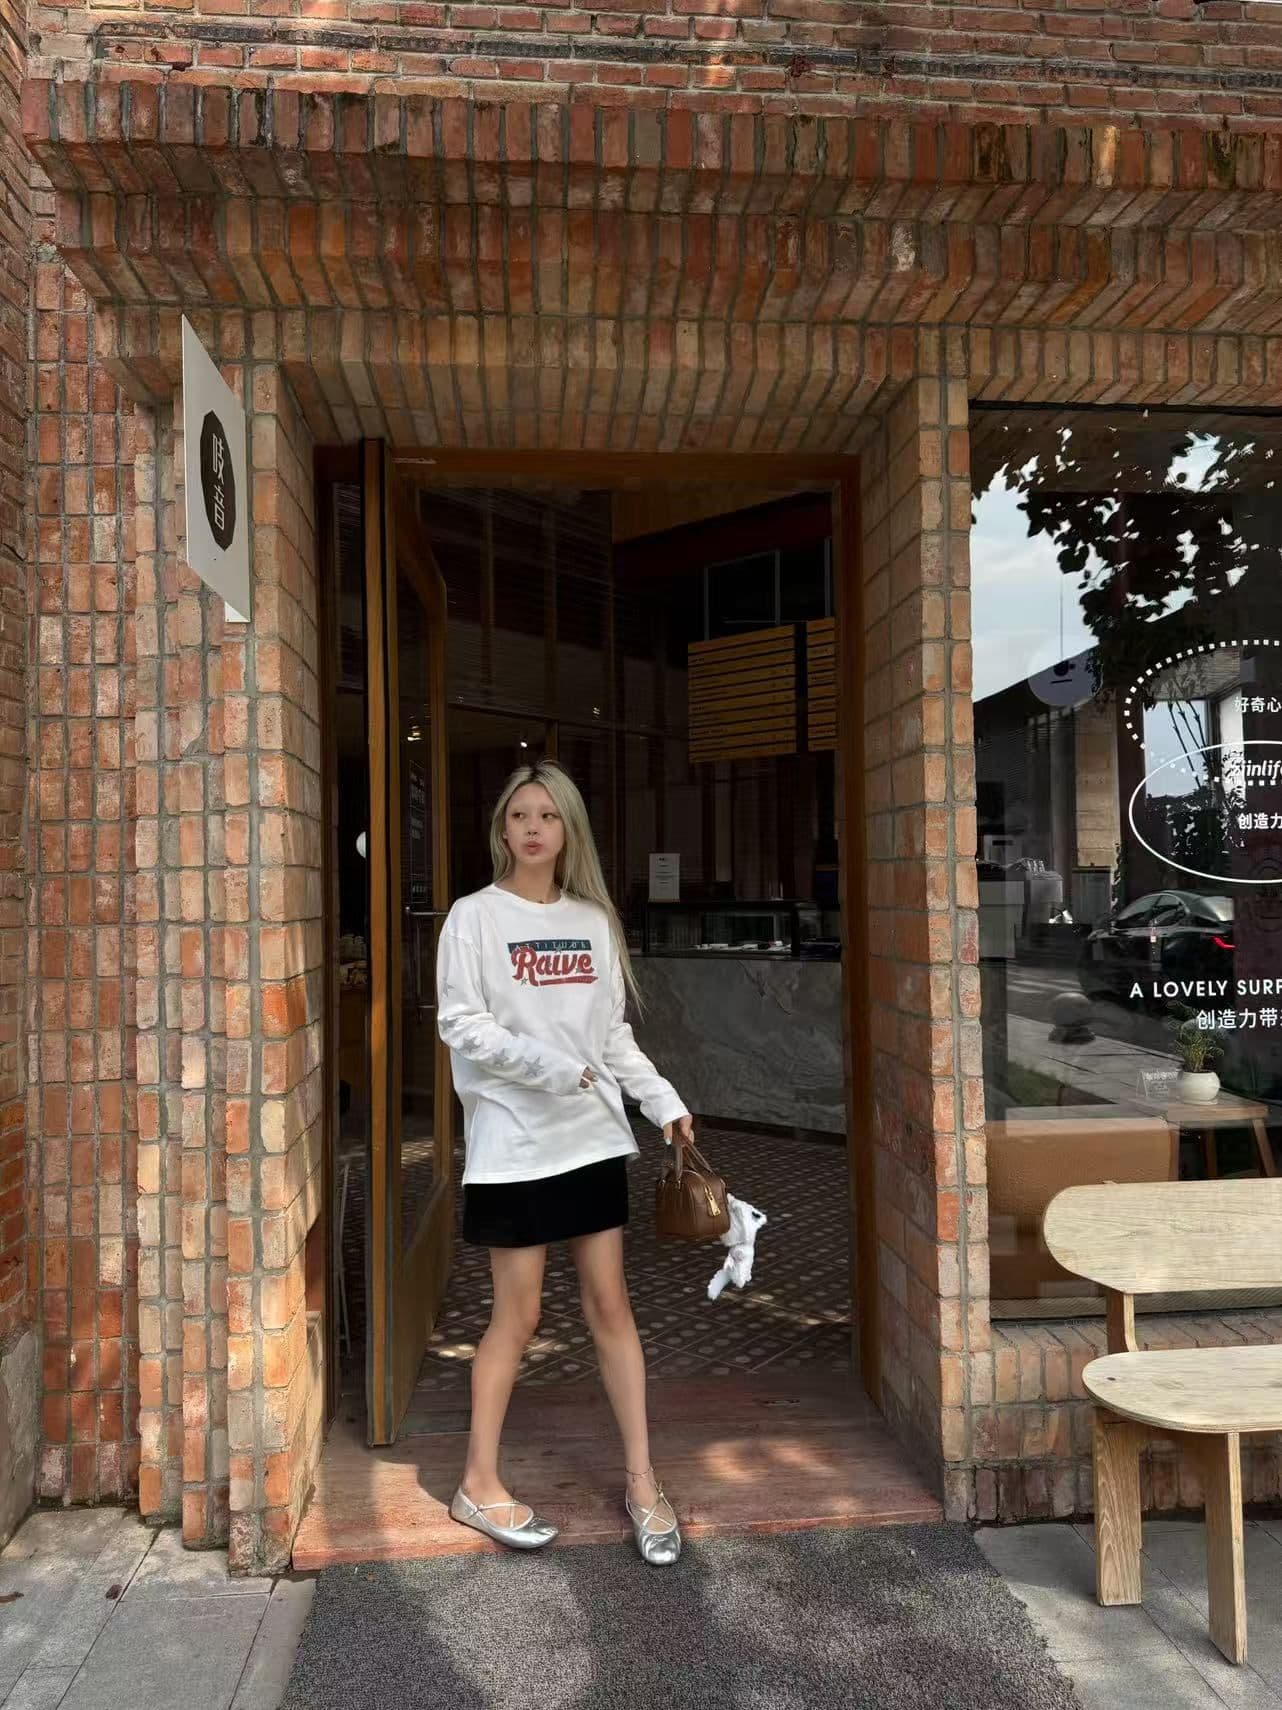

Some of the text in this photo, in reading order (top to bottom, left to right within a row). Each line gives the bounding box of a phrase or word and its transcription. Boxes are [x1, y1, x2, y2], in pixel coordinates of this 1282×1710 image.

[1234, 696, 1282, 713] 好奇心
[1238, 812, 1282, 830] 创造力
[1129, 982, 1144, 998] A
[1153, 980, 1228, 998] LOVELY
[1197, 1007, 1282, 1030] 创造力带
